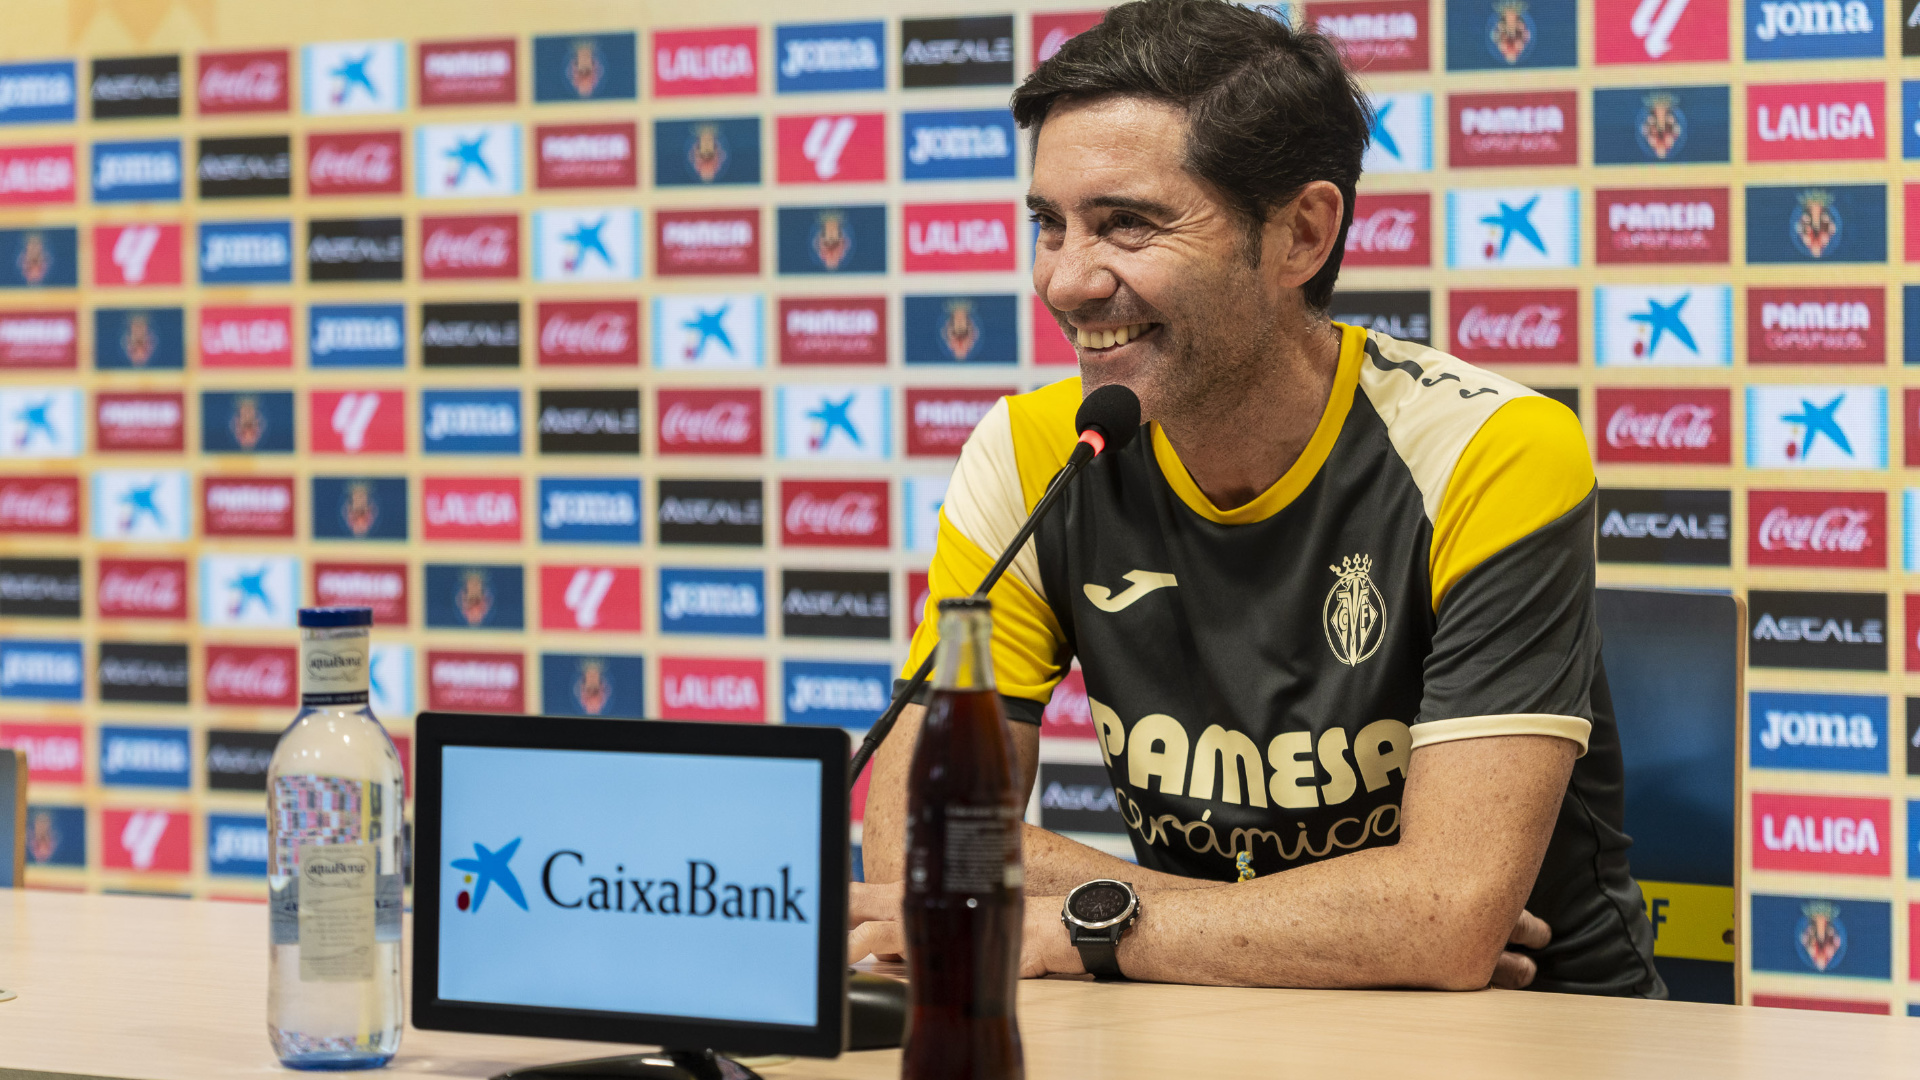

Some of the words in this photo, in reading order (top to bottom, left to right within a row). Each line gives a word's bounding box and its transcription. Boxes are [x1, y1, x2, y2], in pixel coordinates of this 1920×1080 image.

[660, 46, 753, 80] LALIGA
[1758, 103, 1874, 140] LALIGA
[909, 220, 1008, 254] LALIGA
[426, 493, 515, 525] LALIGA
[664, 676, 758, 709] LALIGA
[1089, 696, 1413, 809] PAMESA
[1762, 814, 1880, 855] LALIGA
[541, 850, 808, 922] CaixaBank
